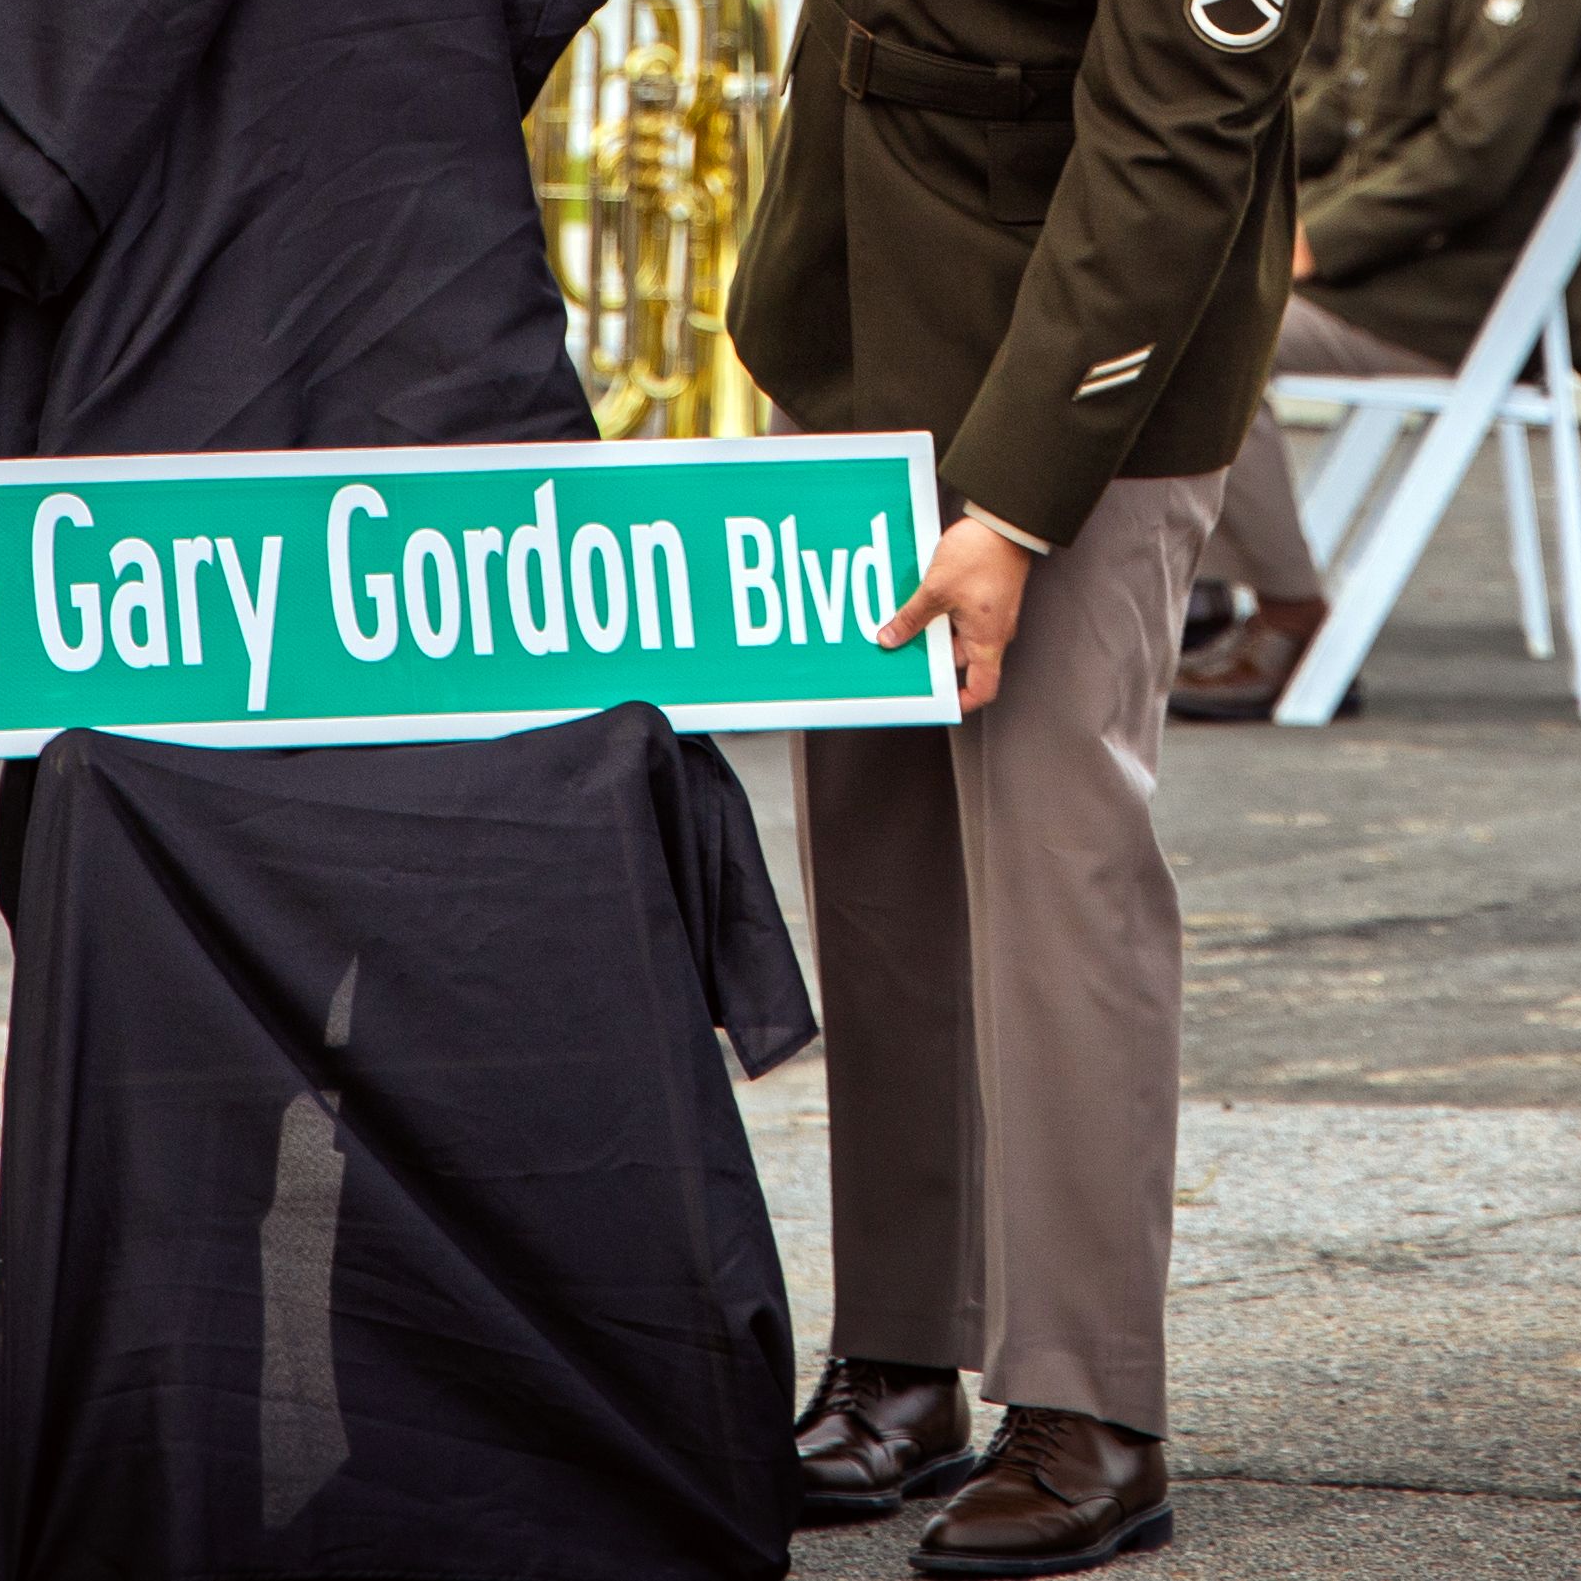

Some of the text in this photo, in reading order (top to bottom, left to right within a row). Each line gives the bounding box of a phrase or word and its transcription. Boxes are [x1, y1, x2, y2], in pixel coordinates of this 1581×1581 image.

[31, 492, 284, 712] Gary
[326, 477, 696, 663] Gordon
[724, 511, 897, 647] Blvd
